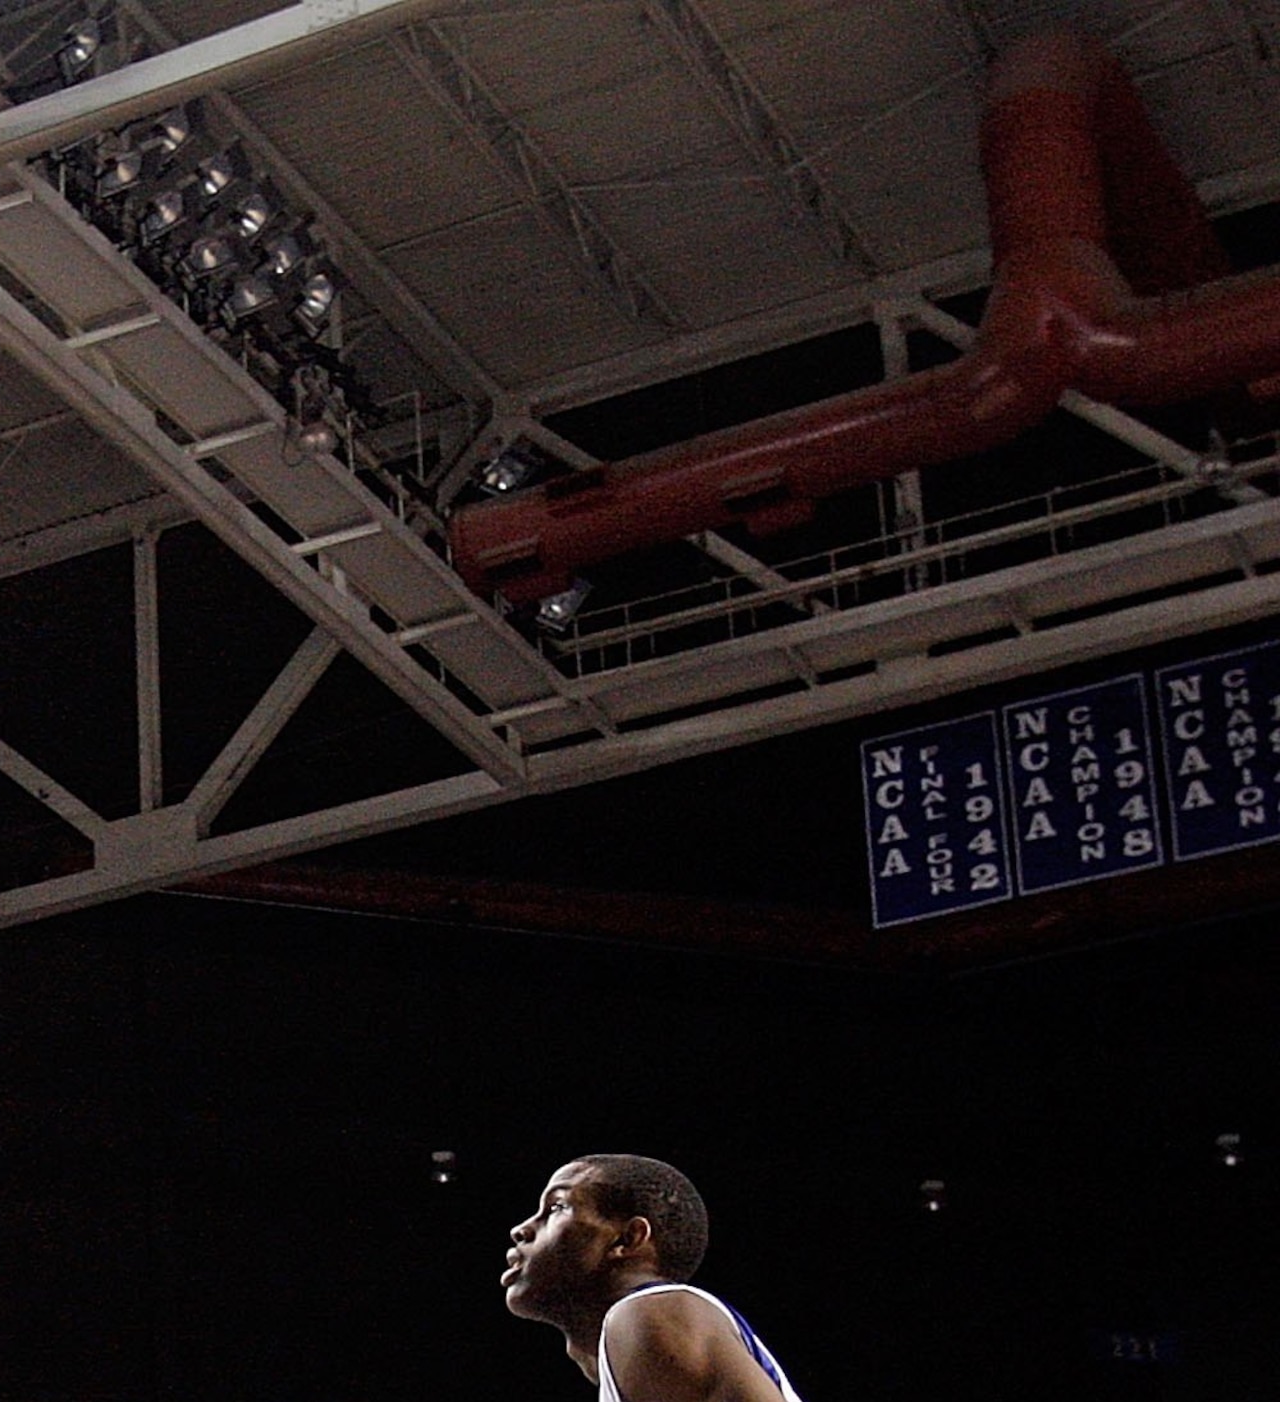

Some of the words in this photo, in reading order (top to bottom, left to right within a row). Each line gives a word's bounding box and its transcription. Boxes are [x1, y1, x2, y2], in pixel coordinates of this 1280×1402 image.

[919, 745, 947, 821] FINAL
[1014, 707, 1057, 842] NCAA
[1066, 705, 1106, 863] CHAMPION
[1113, 727, 1155, 858] 1948
[1167, 675, 1216, 811] NCAA
[1220, 668, 1266, 828] CHAMPION
[871, 746, 912, 878] NCAA
[926, 832, 956, 896] FOUR
[964, 762, 1001, 892] 1942
